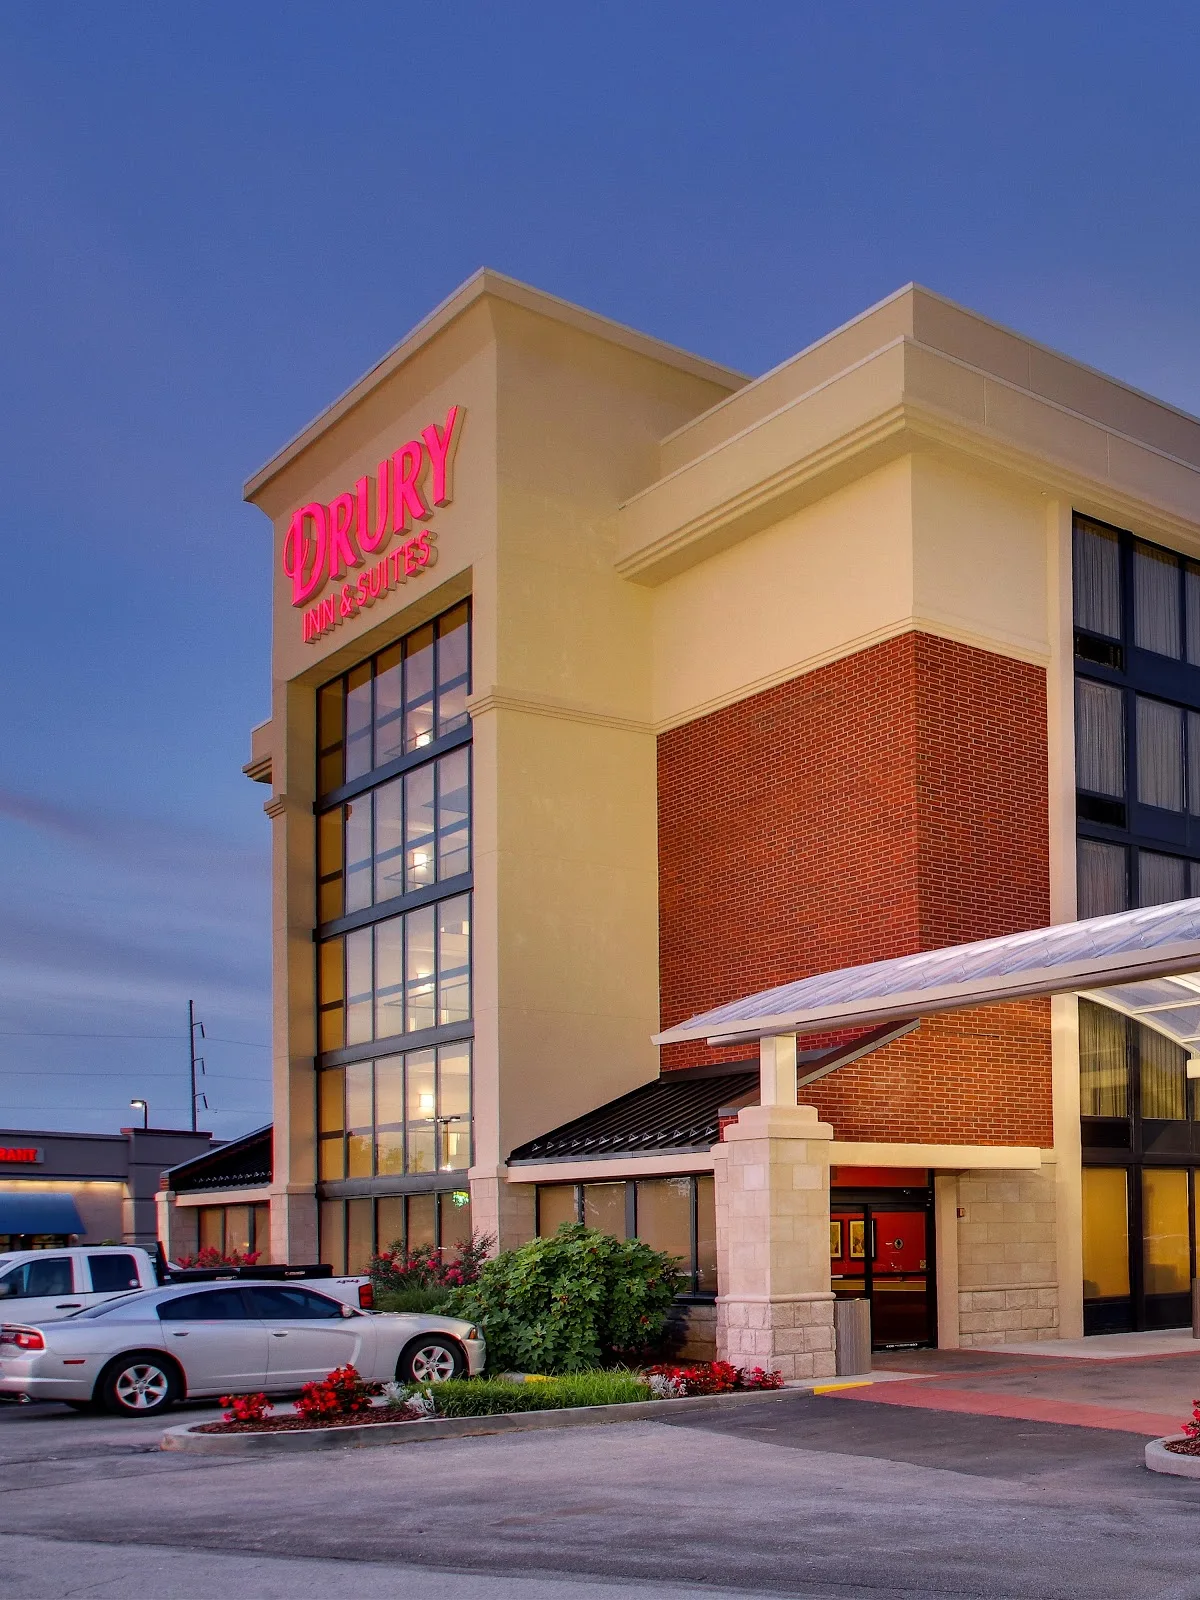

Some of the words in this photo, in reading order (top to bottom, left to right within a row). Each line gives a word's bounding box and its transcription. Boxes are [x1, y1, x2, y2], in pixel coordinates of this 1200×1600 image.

[282, 404, 463, 607] DRURY
[303, 593, 338, 642] INN
[339, 584, 357, 618] &
[356, 529, 434, 607] SUITES
